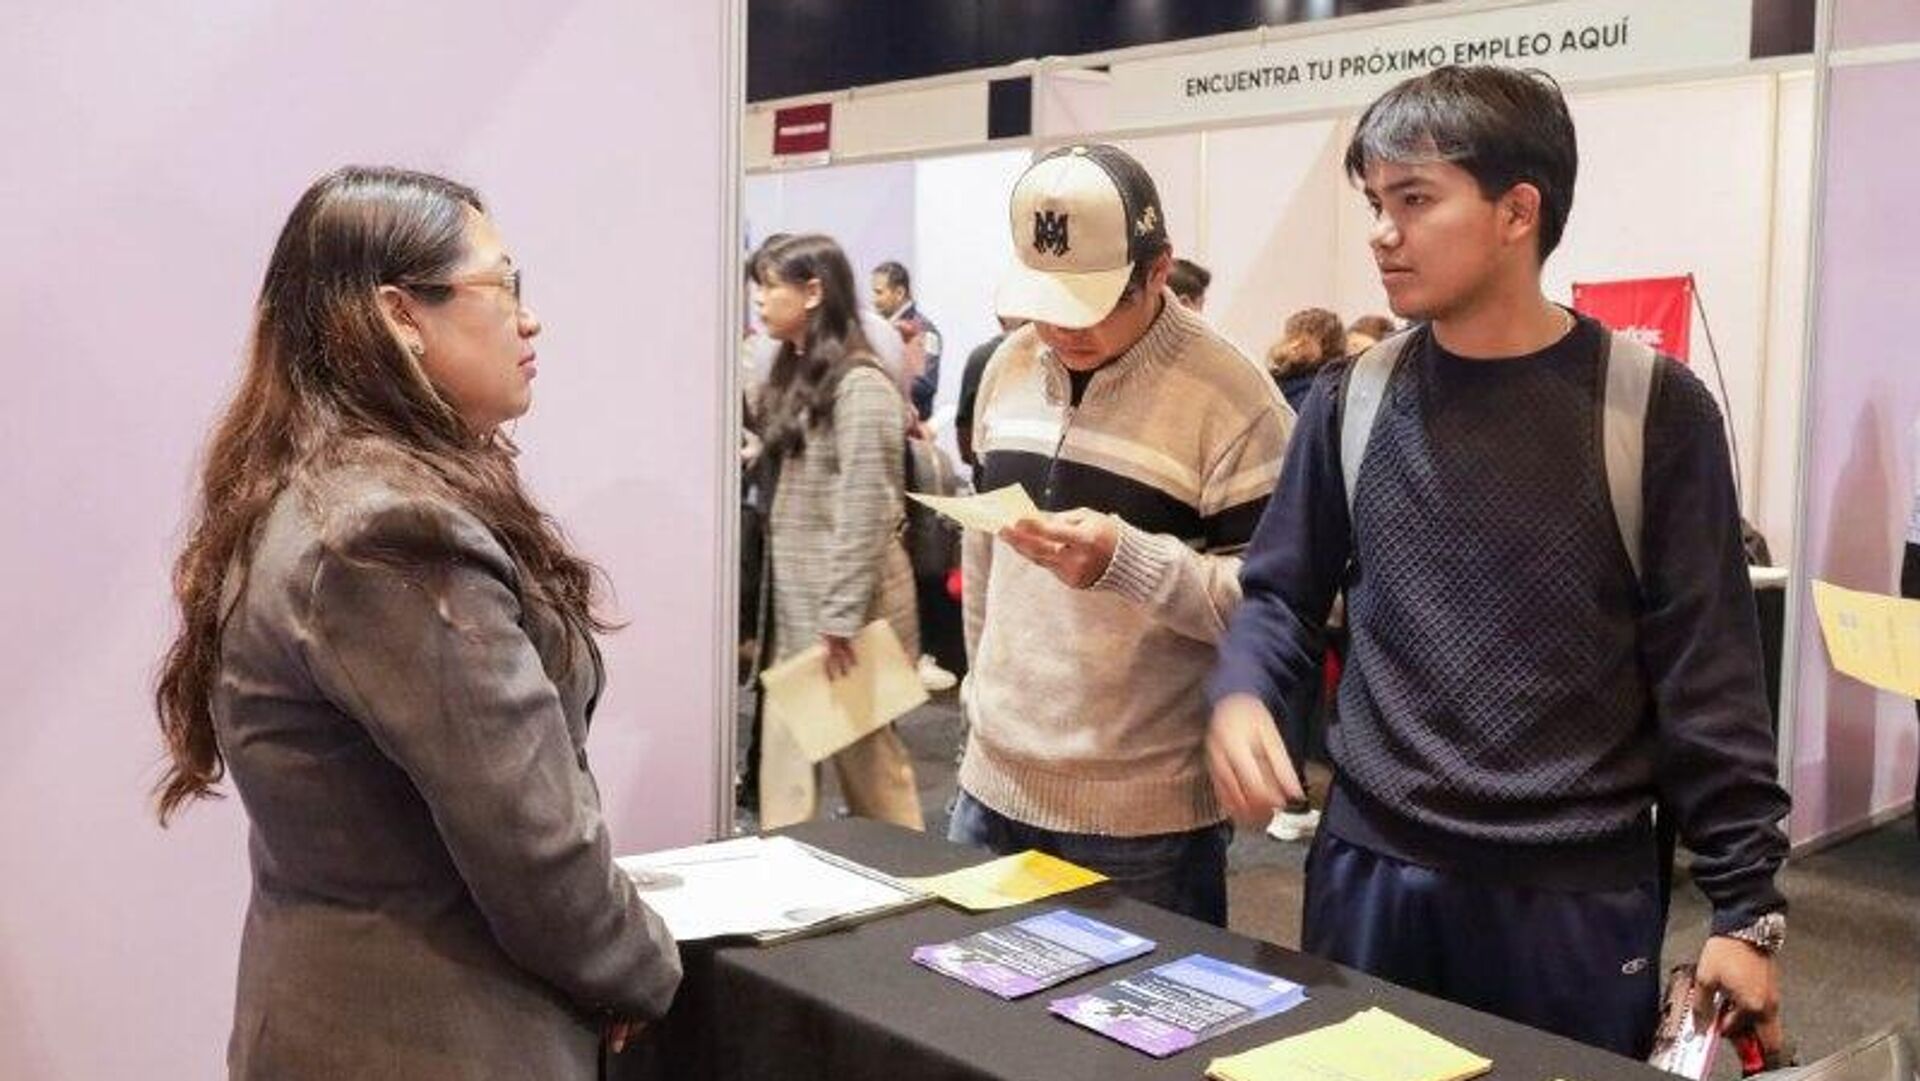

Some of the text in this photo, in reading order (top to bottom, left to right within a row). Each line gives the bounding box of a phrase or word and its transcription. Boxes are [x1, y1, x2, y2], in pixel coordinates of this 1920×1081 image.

[1186, 16, 1629, 97] ENCUENTRA TU PRÓXIMO EMPLEO AQUÍ
